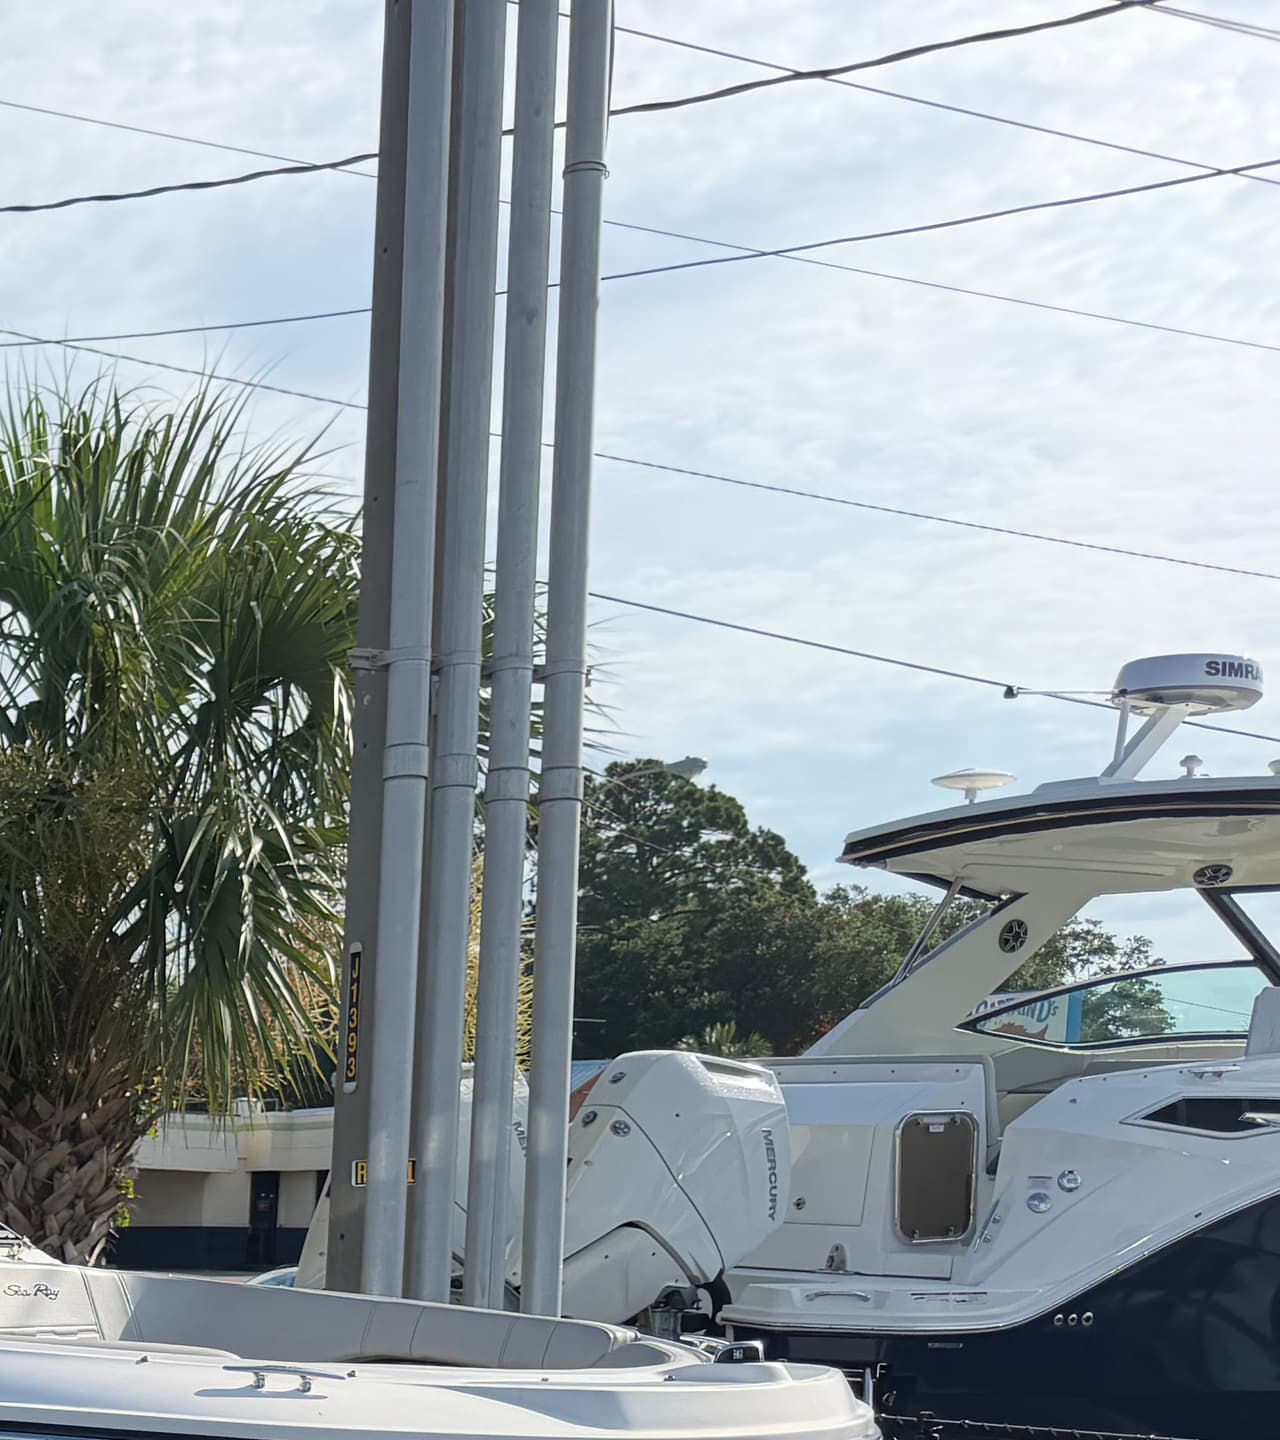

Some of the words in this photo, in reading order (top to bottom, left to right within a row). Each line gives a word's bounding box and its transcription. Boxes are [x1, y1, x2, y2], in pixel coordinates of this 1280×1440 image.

[761, 1129, 778, 1222] MERCURY
[3, 1284, 32, 1297] Sea
[33, 1283, 60, 1301] Ray
